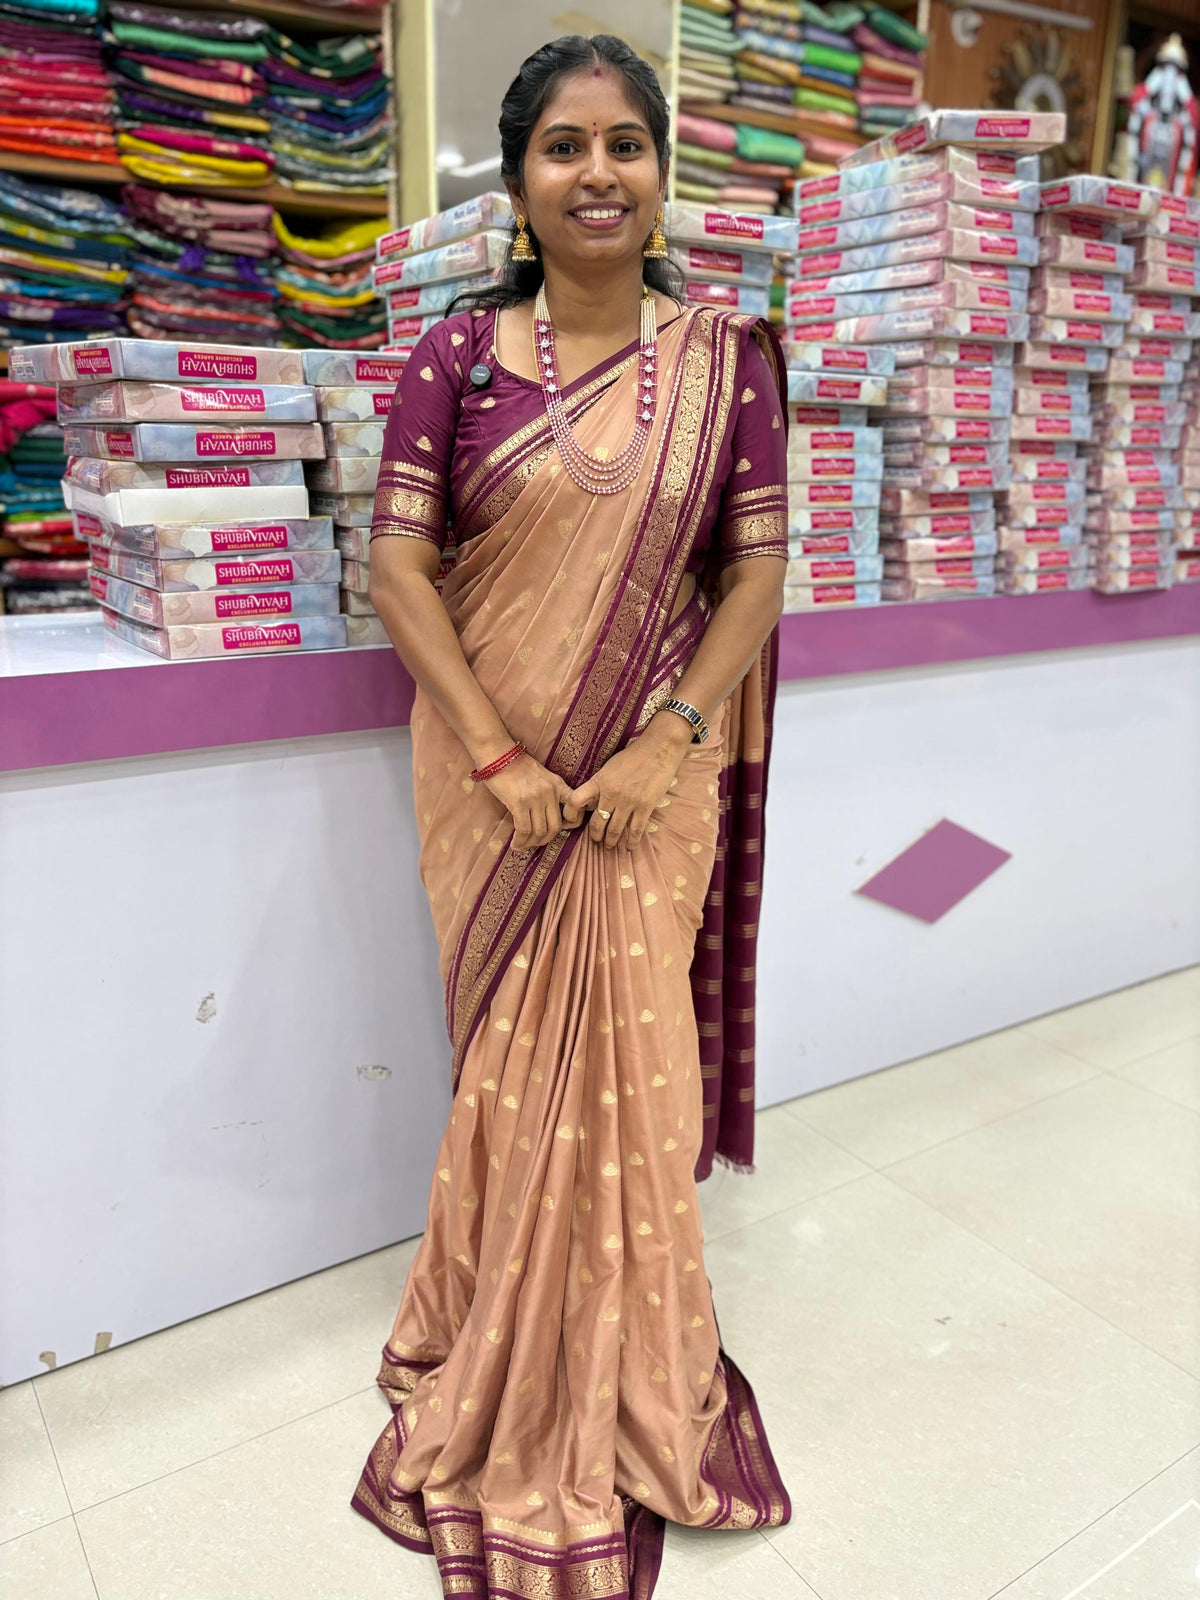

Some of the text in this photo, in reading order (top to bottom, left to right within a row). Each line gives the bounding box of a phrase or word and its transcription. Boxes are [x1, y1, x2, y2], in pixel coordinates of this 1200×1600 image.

[182, 357, 254, 376] SHUBHVIVAH
[184, 390, 261, 407] SHUBHVIVAH
[200, 438, 273, 454] SHUBHVIVAH
[169, 470, 246, 485] SHUBHVIVAH
[214, 529, 284, 543] SHUBHVIVAH
[218, 563, 290, 577] SHUBHVIVAH
[218, 595, 288, 610] SHUBHVIVAH
[225, 627, 297, 642] SHUBHVIVAH
